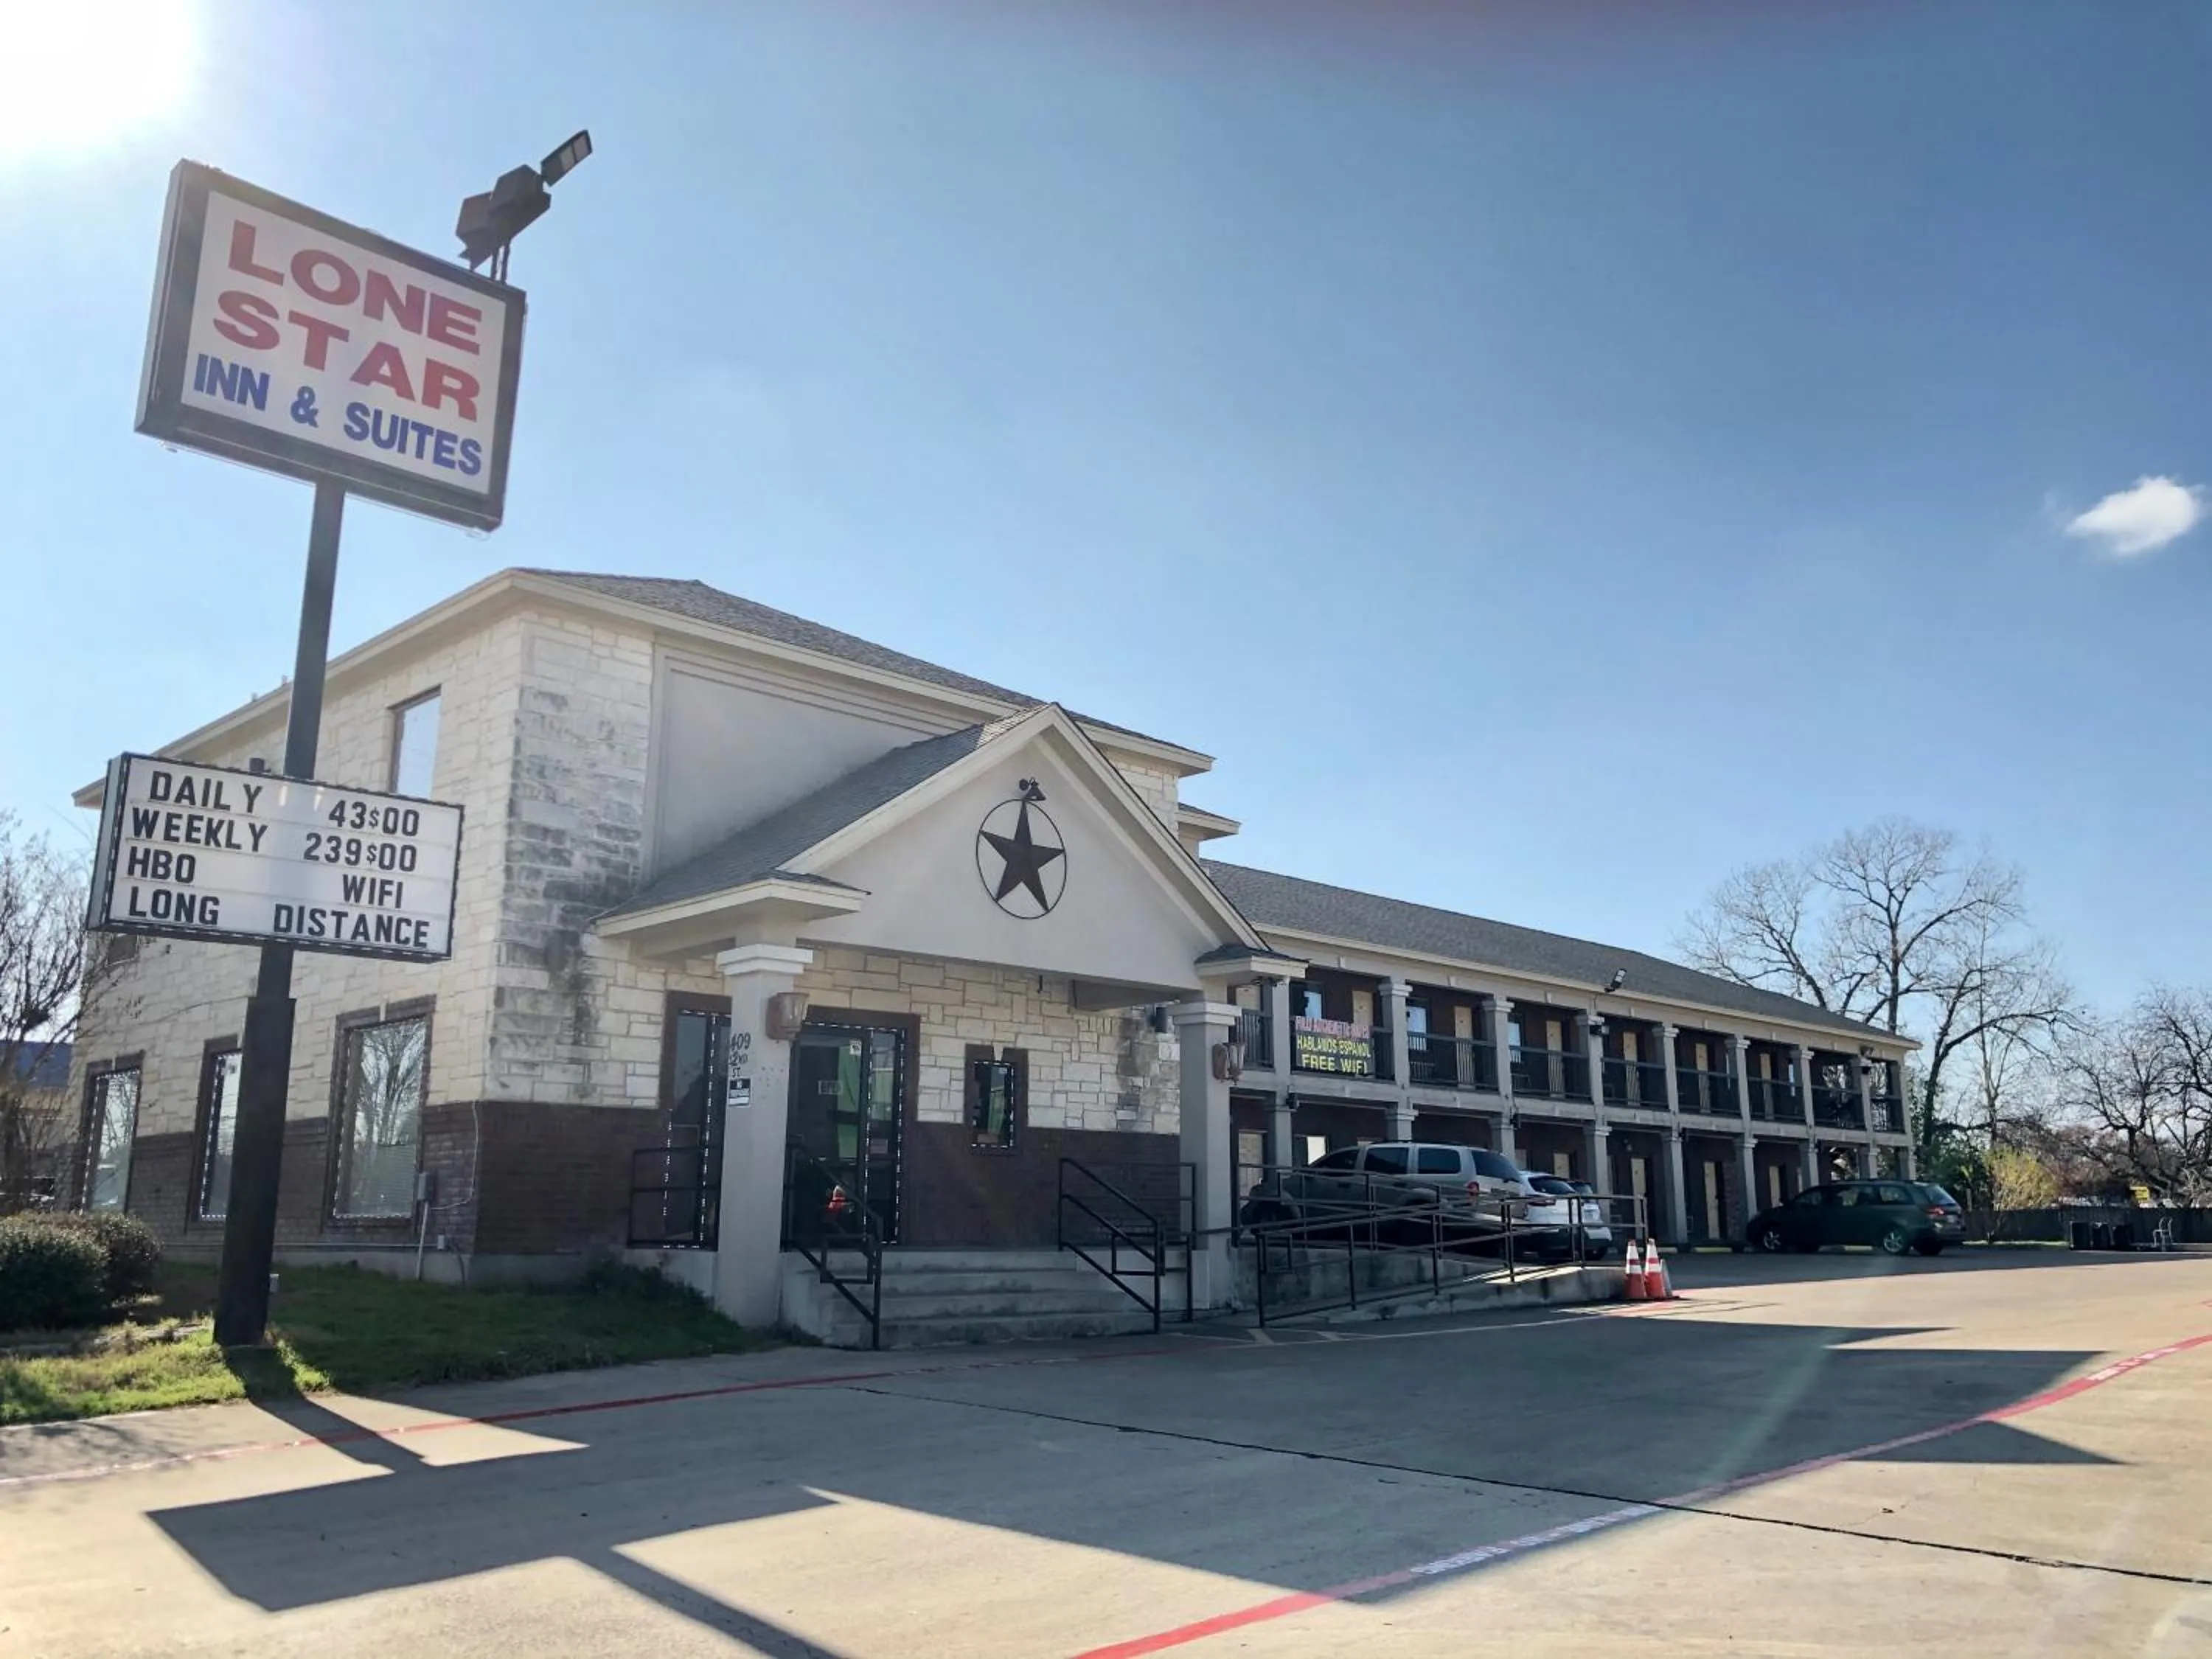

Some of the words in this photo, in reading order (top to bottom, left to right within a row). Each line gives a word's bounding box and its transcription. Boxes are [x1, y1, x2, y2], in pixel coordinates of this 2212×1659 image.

[228, 220, 482, 355] LONE
[213, 290, 481, 422] STAR
[194, 354, 270, 411] INN
[291, 386, 319, 428] &
[344, 403, 482, 475] SUITES
[150, 771, 262, 813] DAILY
[328, 800, 420, 836] 43$00
[133, 807, 268, 852] WEEKLY
[303, 832, 417, 872] 239$00
[127, 846, 196, 883] HBO
[342, 874, 403, 908] WIFI
[129, 886, 220, 925] LONG
[274, 903, 429, 947] DISTANCE
[1302, 1054, 1335, 1071] FREE
[1340, 1059, 1368, 1074] WIFI
